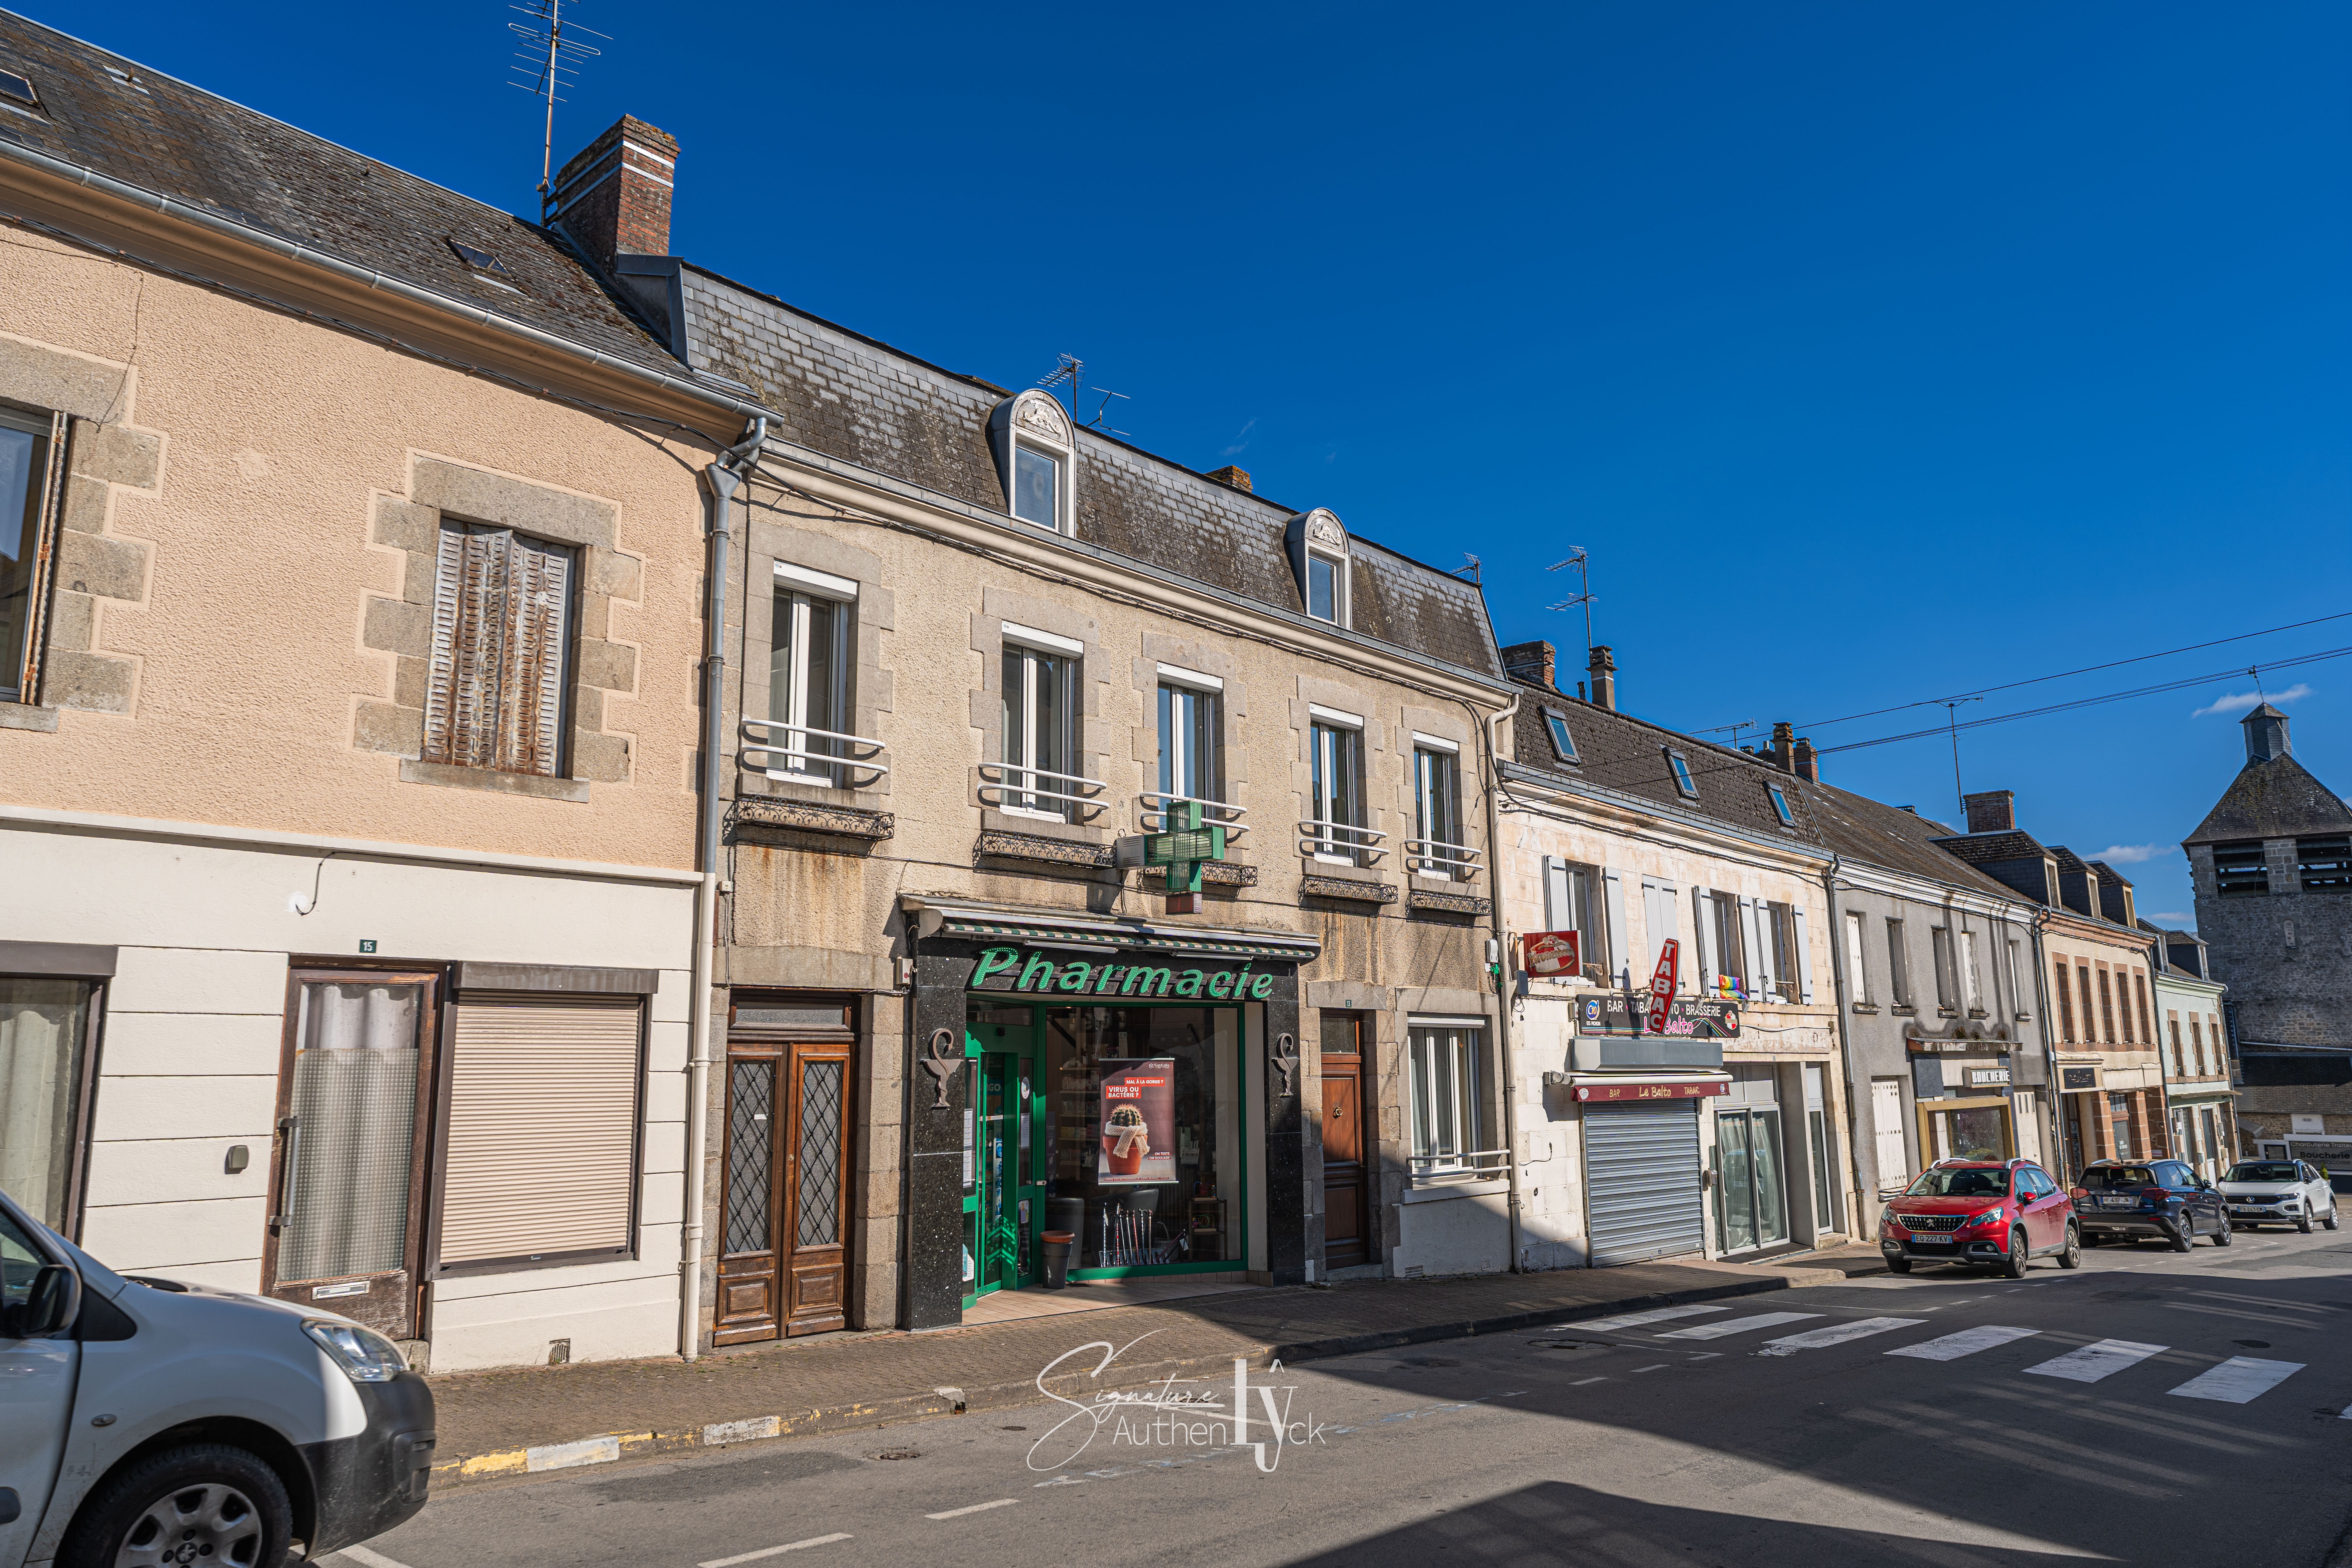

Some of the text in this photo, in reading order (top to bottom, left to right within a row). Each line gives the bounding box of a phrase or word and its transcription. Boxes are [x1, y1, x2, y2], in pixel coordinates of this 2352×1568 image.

[363, 941, 373, 951] 15
[972, 947, 1273, 998] Pharmacie
[1650, 942, 1674, 1028] TABAC
[1607, 1000, 1623, 1013] BAR
[1630, 1001, 1651, 1013] TABA
[1665, 1015, 1693, 1034] Balto
[1972, 1071, 2010, 1083] BOUCHERIE
[1609, 1085, 1700, 1097] BAR Le Balto TABAC
